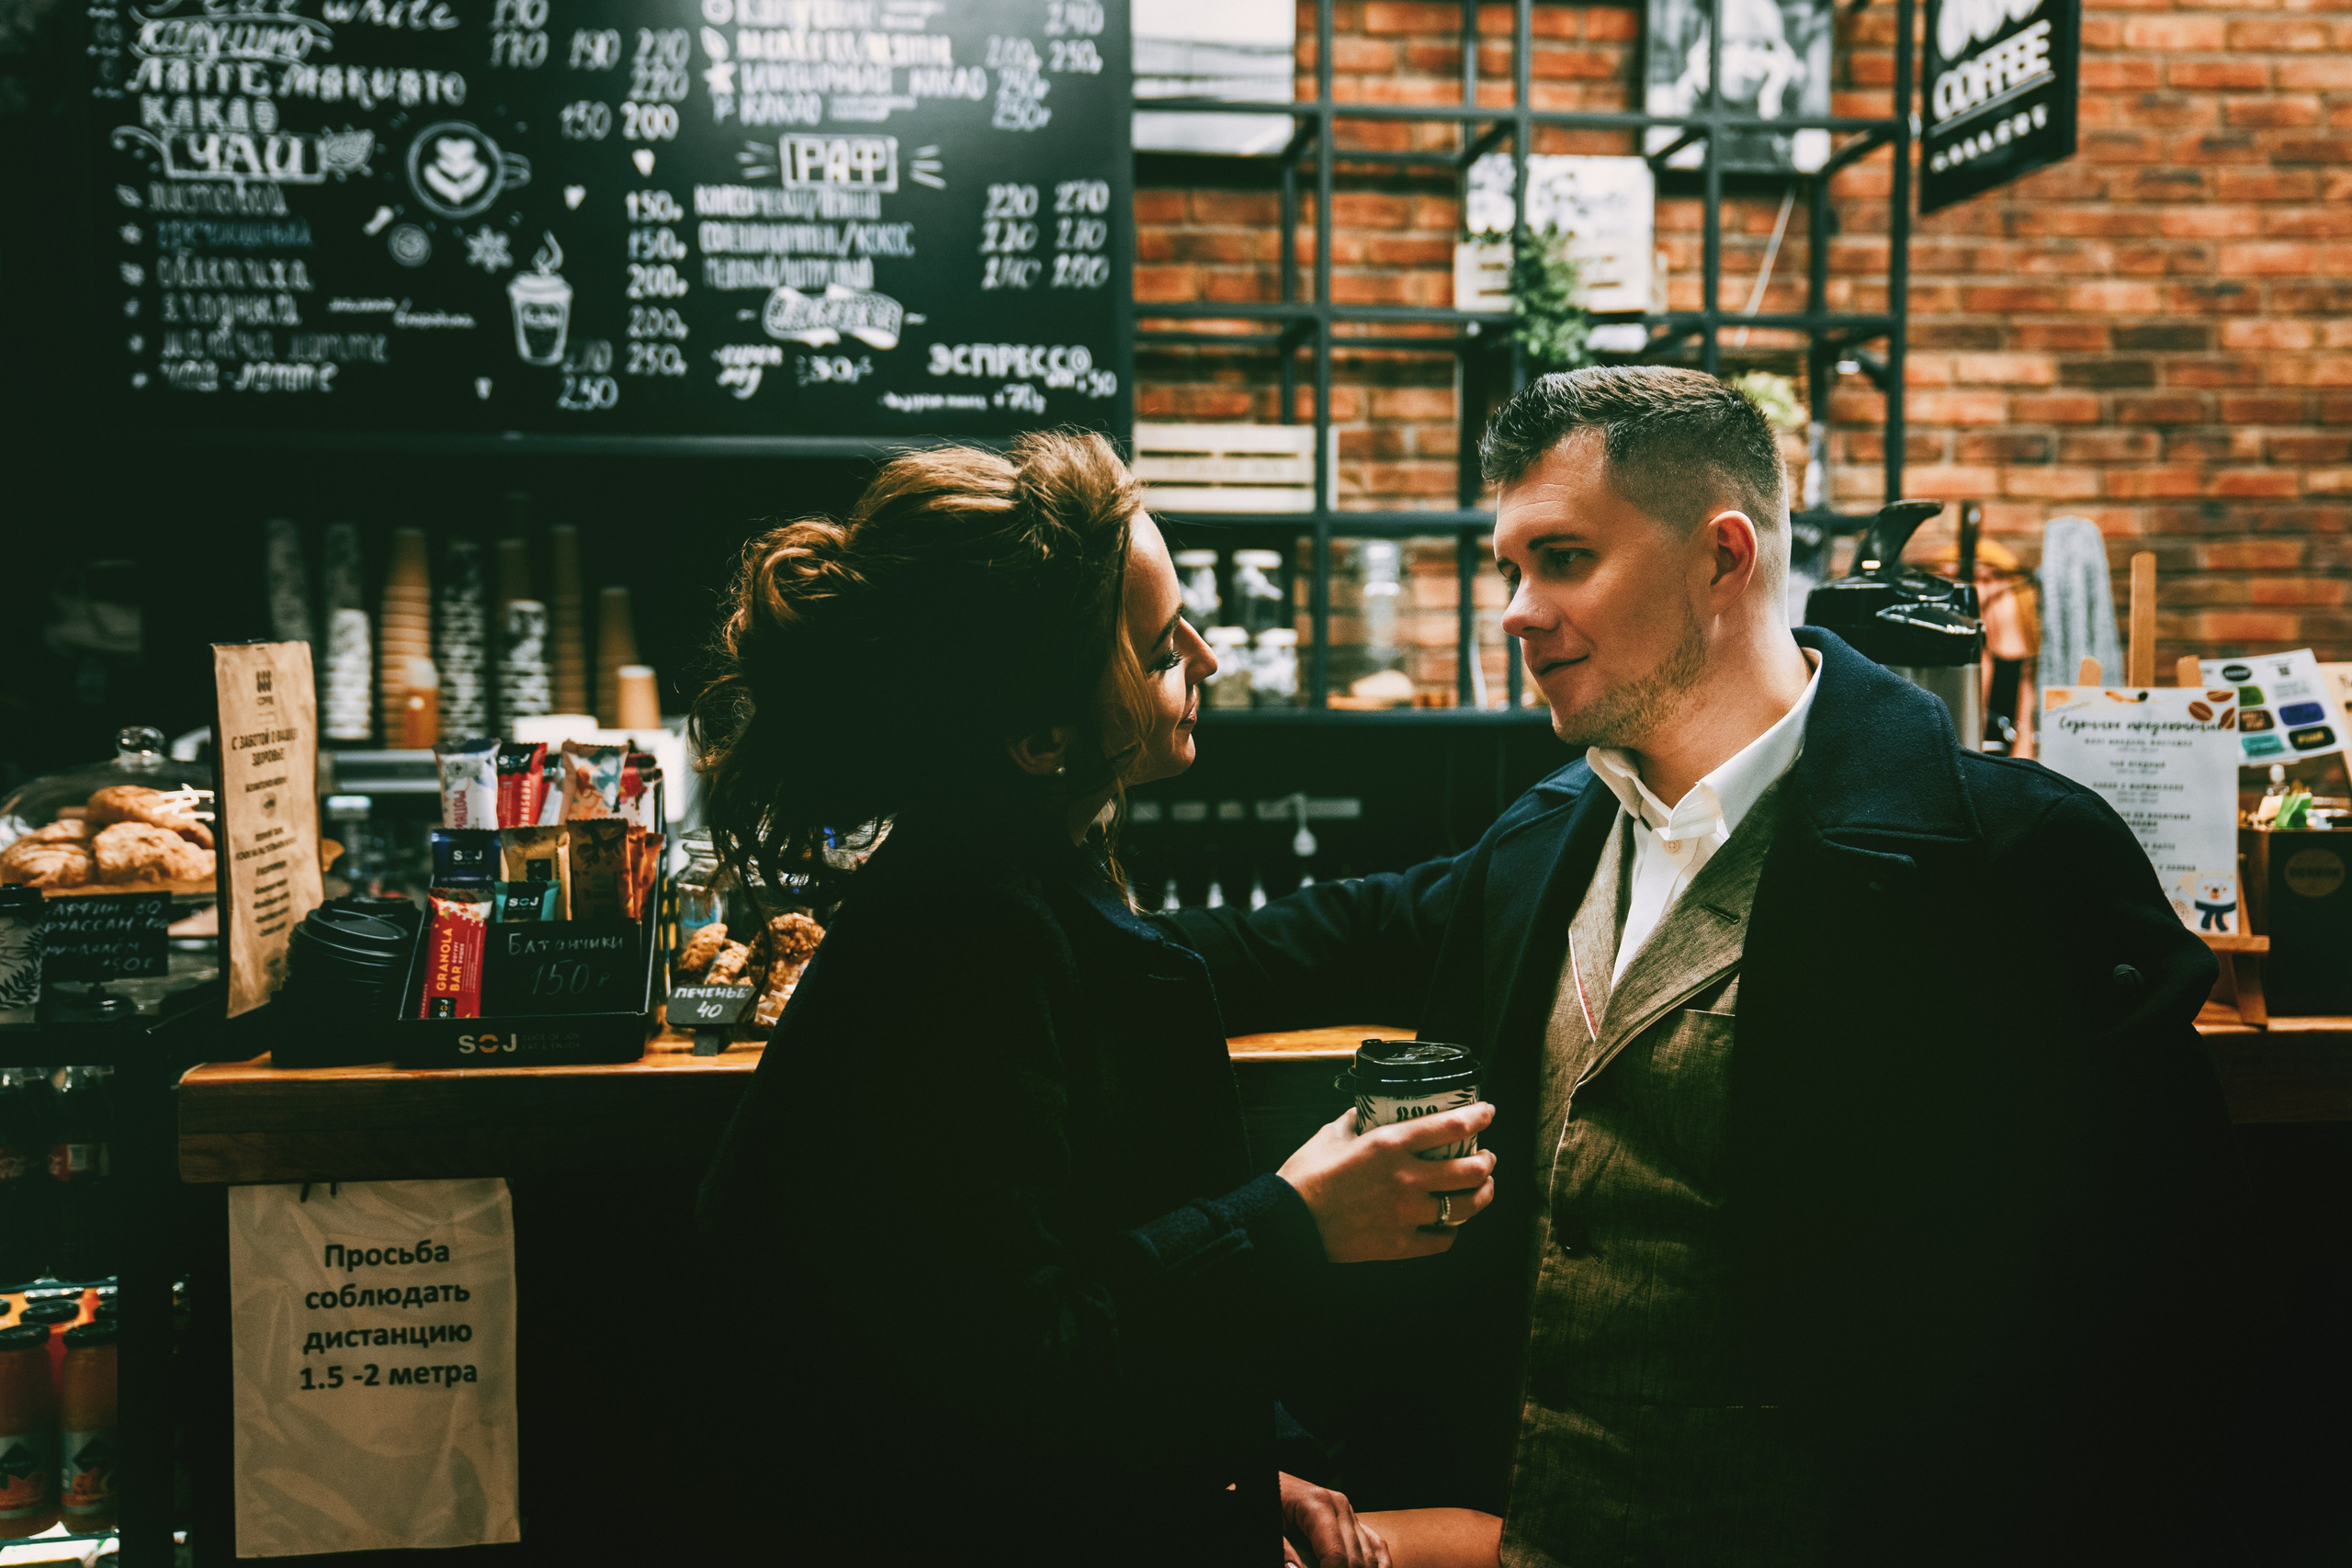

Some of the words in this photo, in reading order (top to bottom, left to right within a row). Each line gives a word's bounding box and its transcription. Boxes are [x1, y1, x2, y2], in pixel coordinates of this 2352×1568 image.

[1933, 18, 2052, 121] COFFEE
[141, 95, 278, 135] КАКАО
[620, 100, 681, 141] 200
[795, 138, 889, 184] РАФ
[927, 342, 1092, 377] ЭСПРЕССО
[508, 896, 540, 908] SOJ
[435, 927, 454, 992] GRANOLA
[448, 965, 463, 992] BAR
[530, 958, 590, 997] 150
[673, 985, 749, 1000] ПЕЧЕНЬЕ
[695, 1000, 724, 1020] 40
[458, 1032, 518, 1055] SOJ
[324, 1239, 450, 1273] Просьба
[305, 1283, 471, 1310] соблюдать
[302, 1323, 473, 1356] дистанцию
[300, 1365, 345, 1391] 1.5
[389, 1362, 478, 1389] метра
